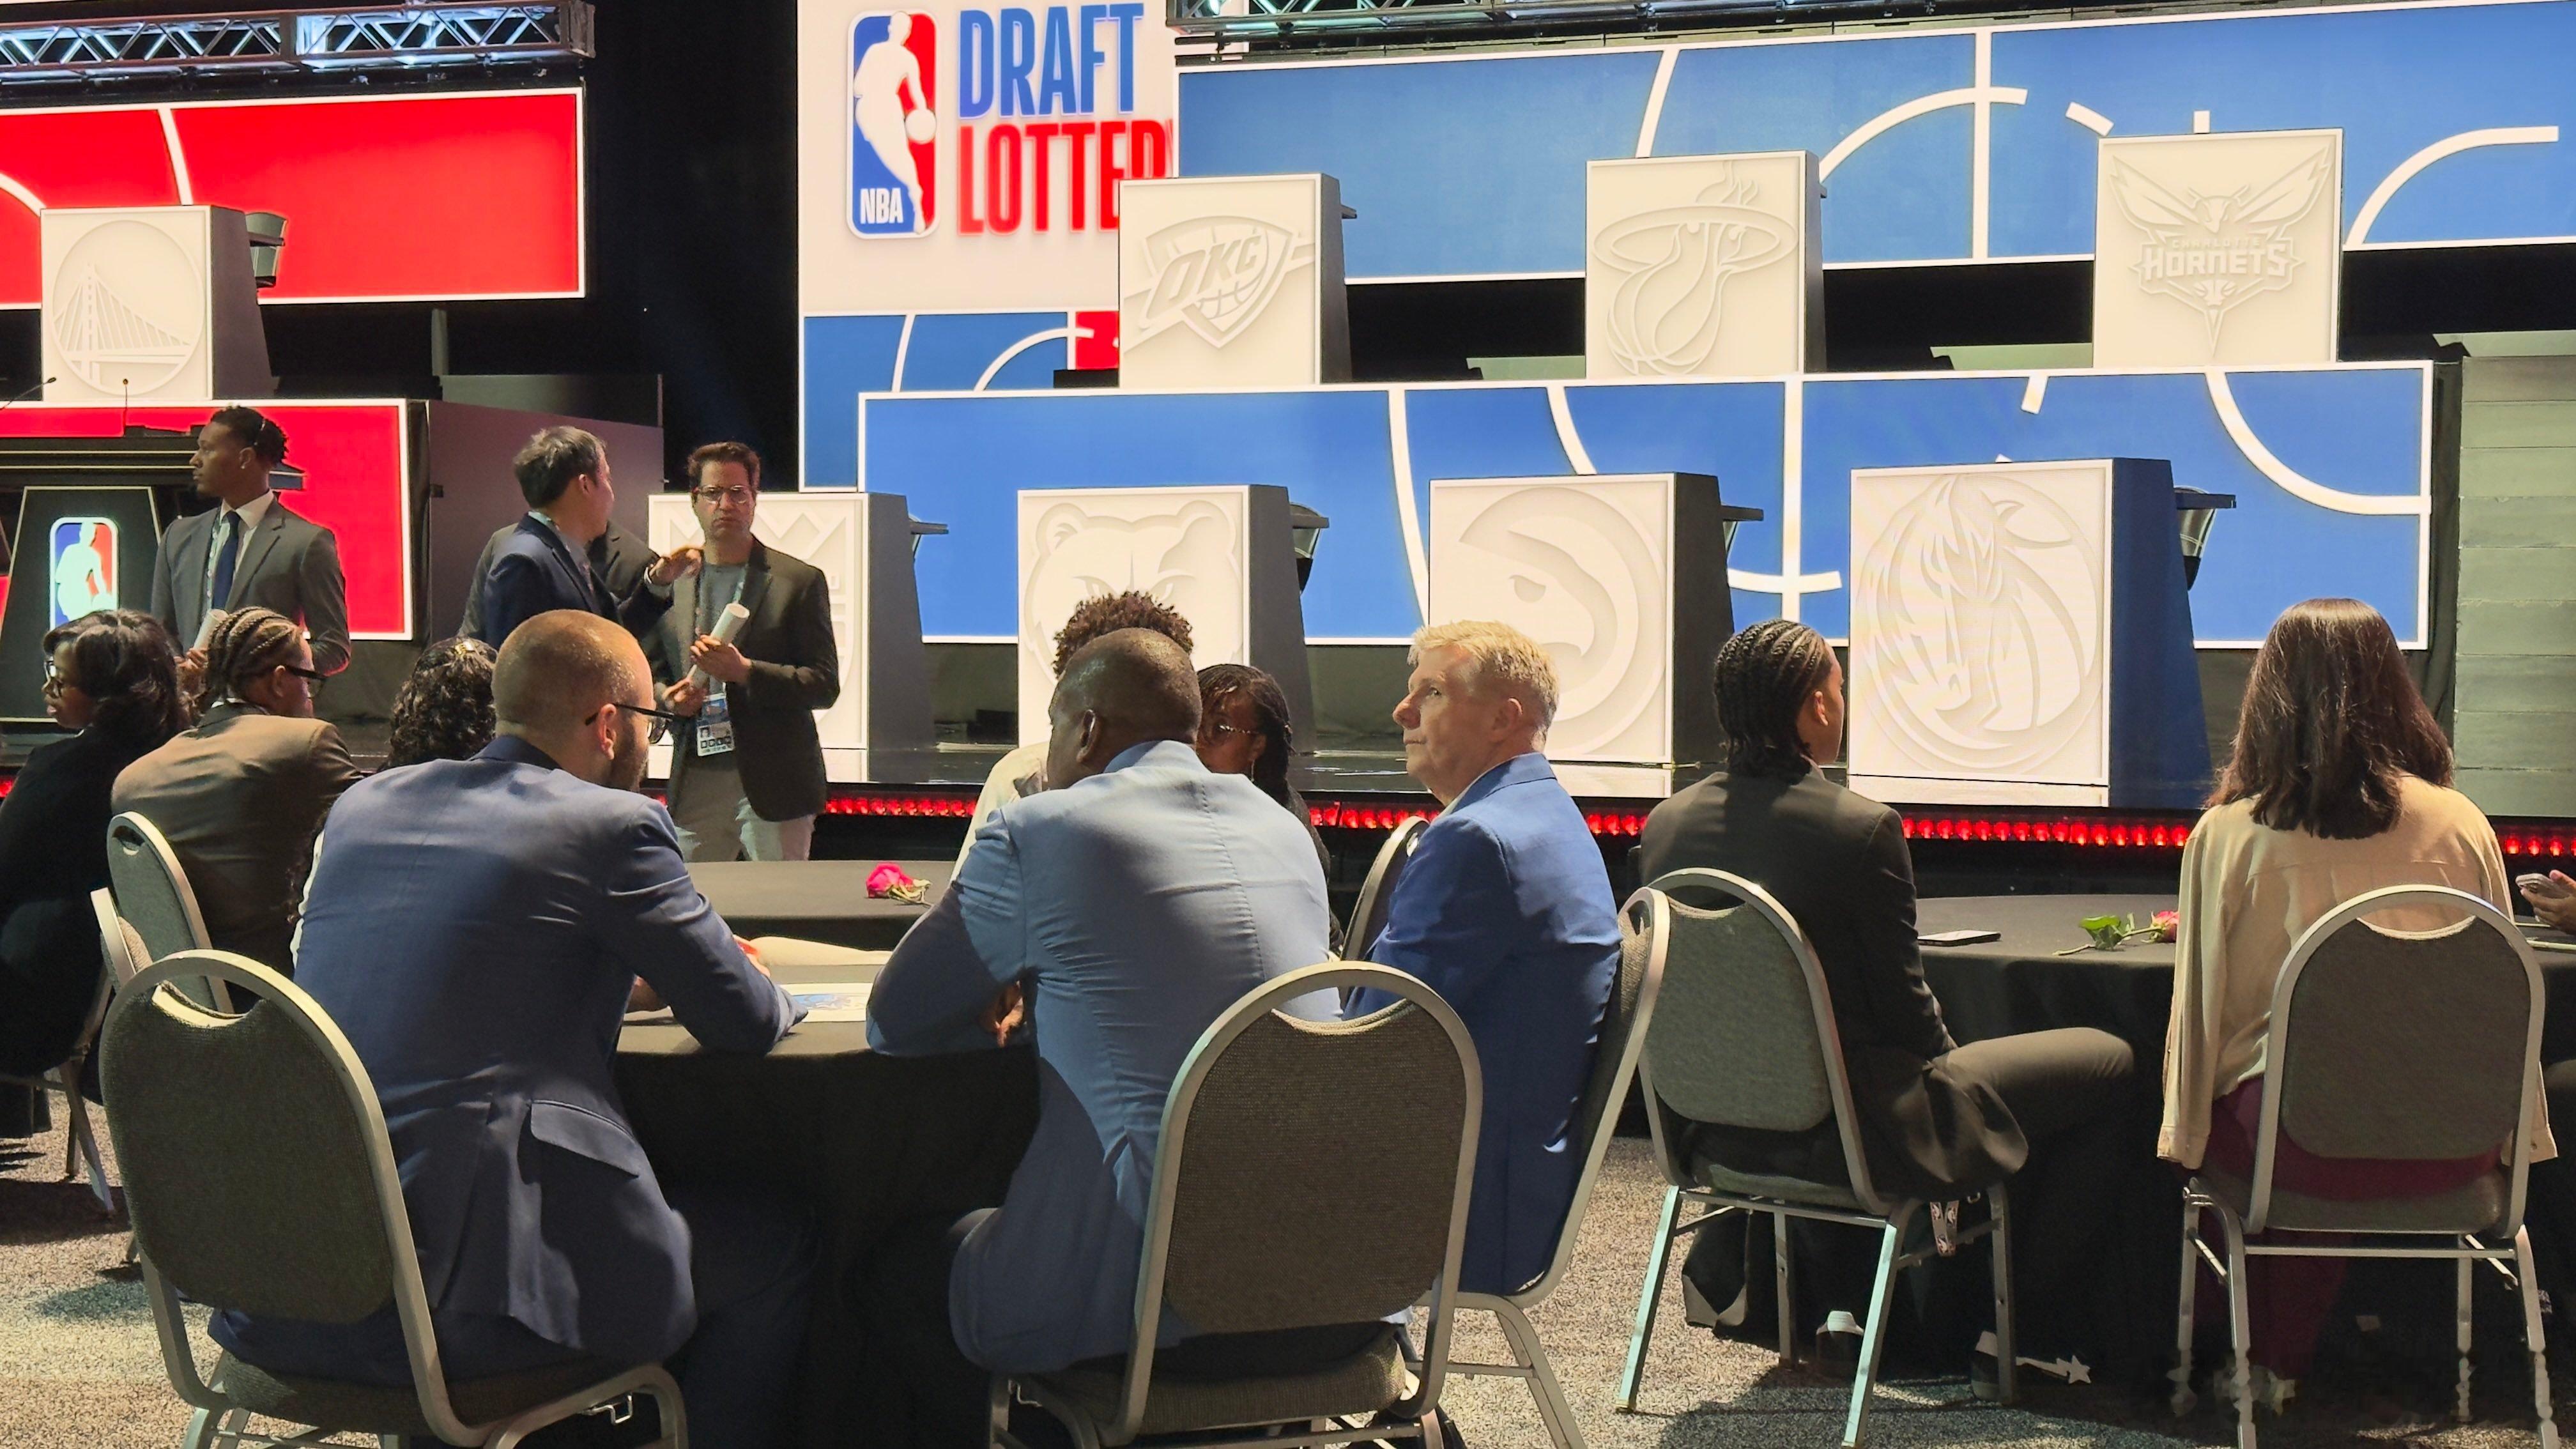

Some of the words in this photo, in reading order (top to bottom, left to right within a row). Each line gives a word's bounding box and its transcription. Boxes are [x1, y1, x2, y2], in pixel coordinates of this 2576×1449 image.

[960, 3, 1144, 119] DRAFT
[860, 187, 903, 224] NBA
[958, 119, 1173, 235] LOTTE
[1146, 234, 1261, 319] OKC
[2143, 243, 2290, 281] HORNETS
